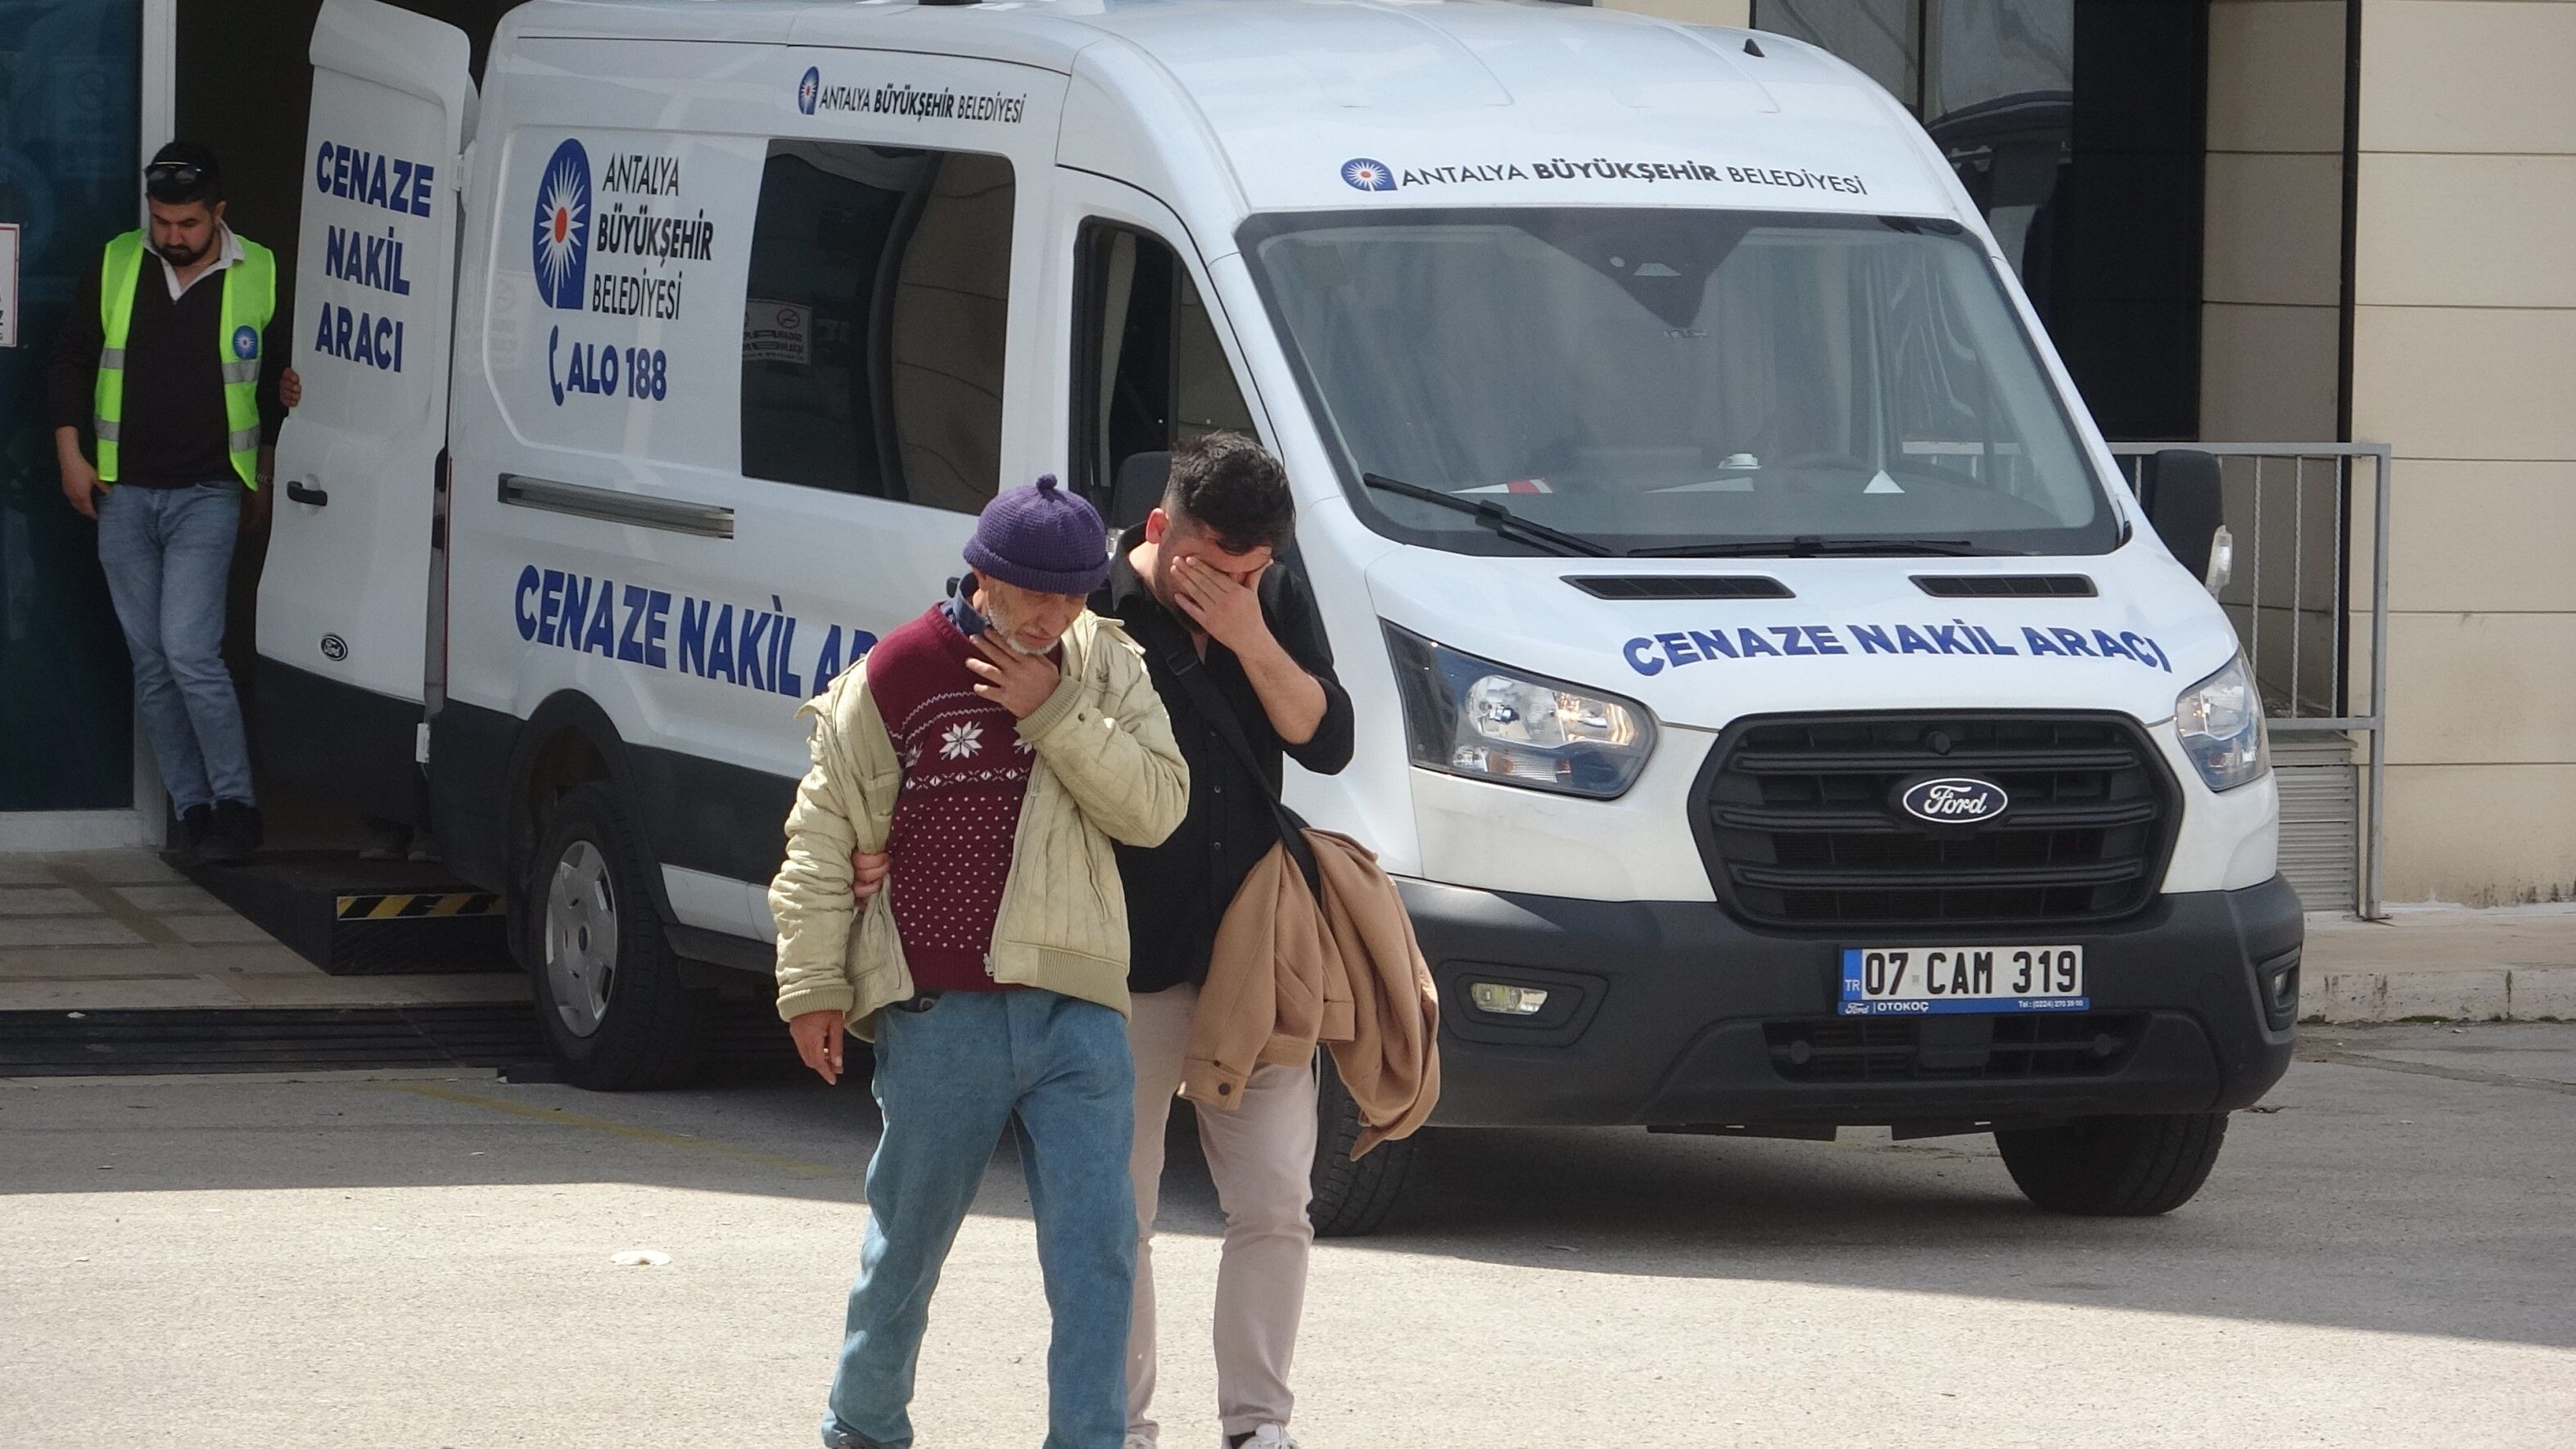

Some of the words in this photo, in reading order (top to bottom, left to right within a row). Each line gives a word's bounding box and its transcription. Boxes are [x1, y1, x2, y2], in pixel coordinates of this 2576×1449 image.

[819, 85, 870, 113] ANTALYA
[873, 83, 955, 122] BÜYÜKŞEHİR
[957, 91, 1027, 123] BELEDİYESİ
[316, 140, 434, 218] CENAZE
[602, 152, 680, 196] ANTALYA
[1402, 163, 1530, 187] ANTALYA
[1532, 157, 1723, 183] BÜYÜKŞEHİR
[1726, 165, 1869, 196] BELEDİYESİ
[325, 224, 410, 296] NAKİL
[596, 201, 714, 269] BÜYÜKŞEHİR
[592, 267, 683, 320] BELEDİYESİ
[314, 301, 404, 373] ARACI
[567, 341, 619, 396] ALO
[626, 346, 667, 402] 188
[515, 564, 671, 670] CENAZE
[1623, 625, 1849, 677] CENAZE
[1846, 618, 2020, 656] NAKİL
[2020, 626, 2172, 674] ARACI
[1924, 785, 1988, 814] Ford
[1845, 980, 1860, 992] TR
[1865, 952, 1909, 995] 07
[1927, 951, 1993, 995] CAM
[2013, 950, 2077, 994] 319
[1845, 1002, 1870, 1014] Ford
[1877, 1001, 1930, 1013] OTOKOÇ
